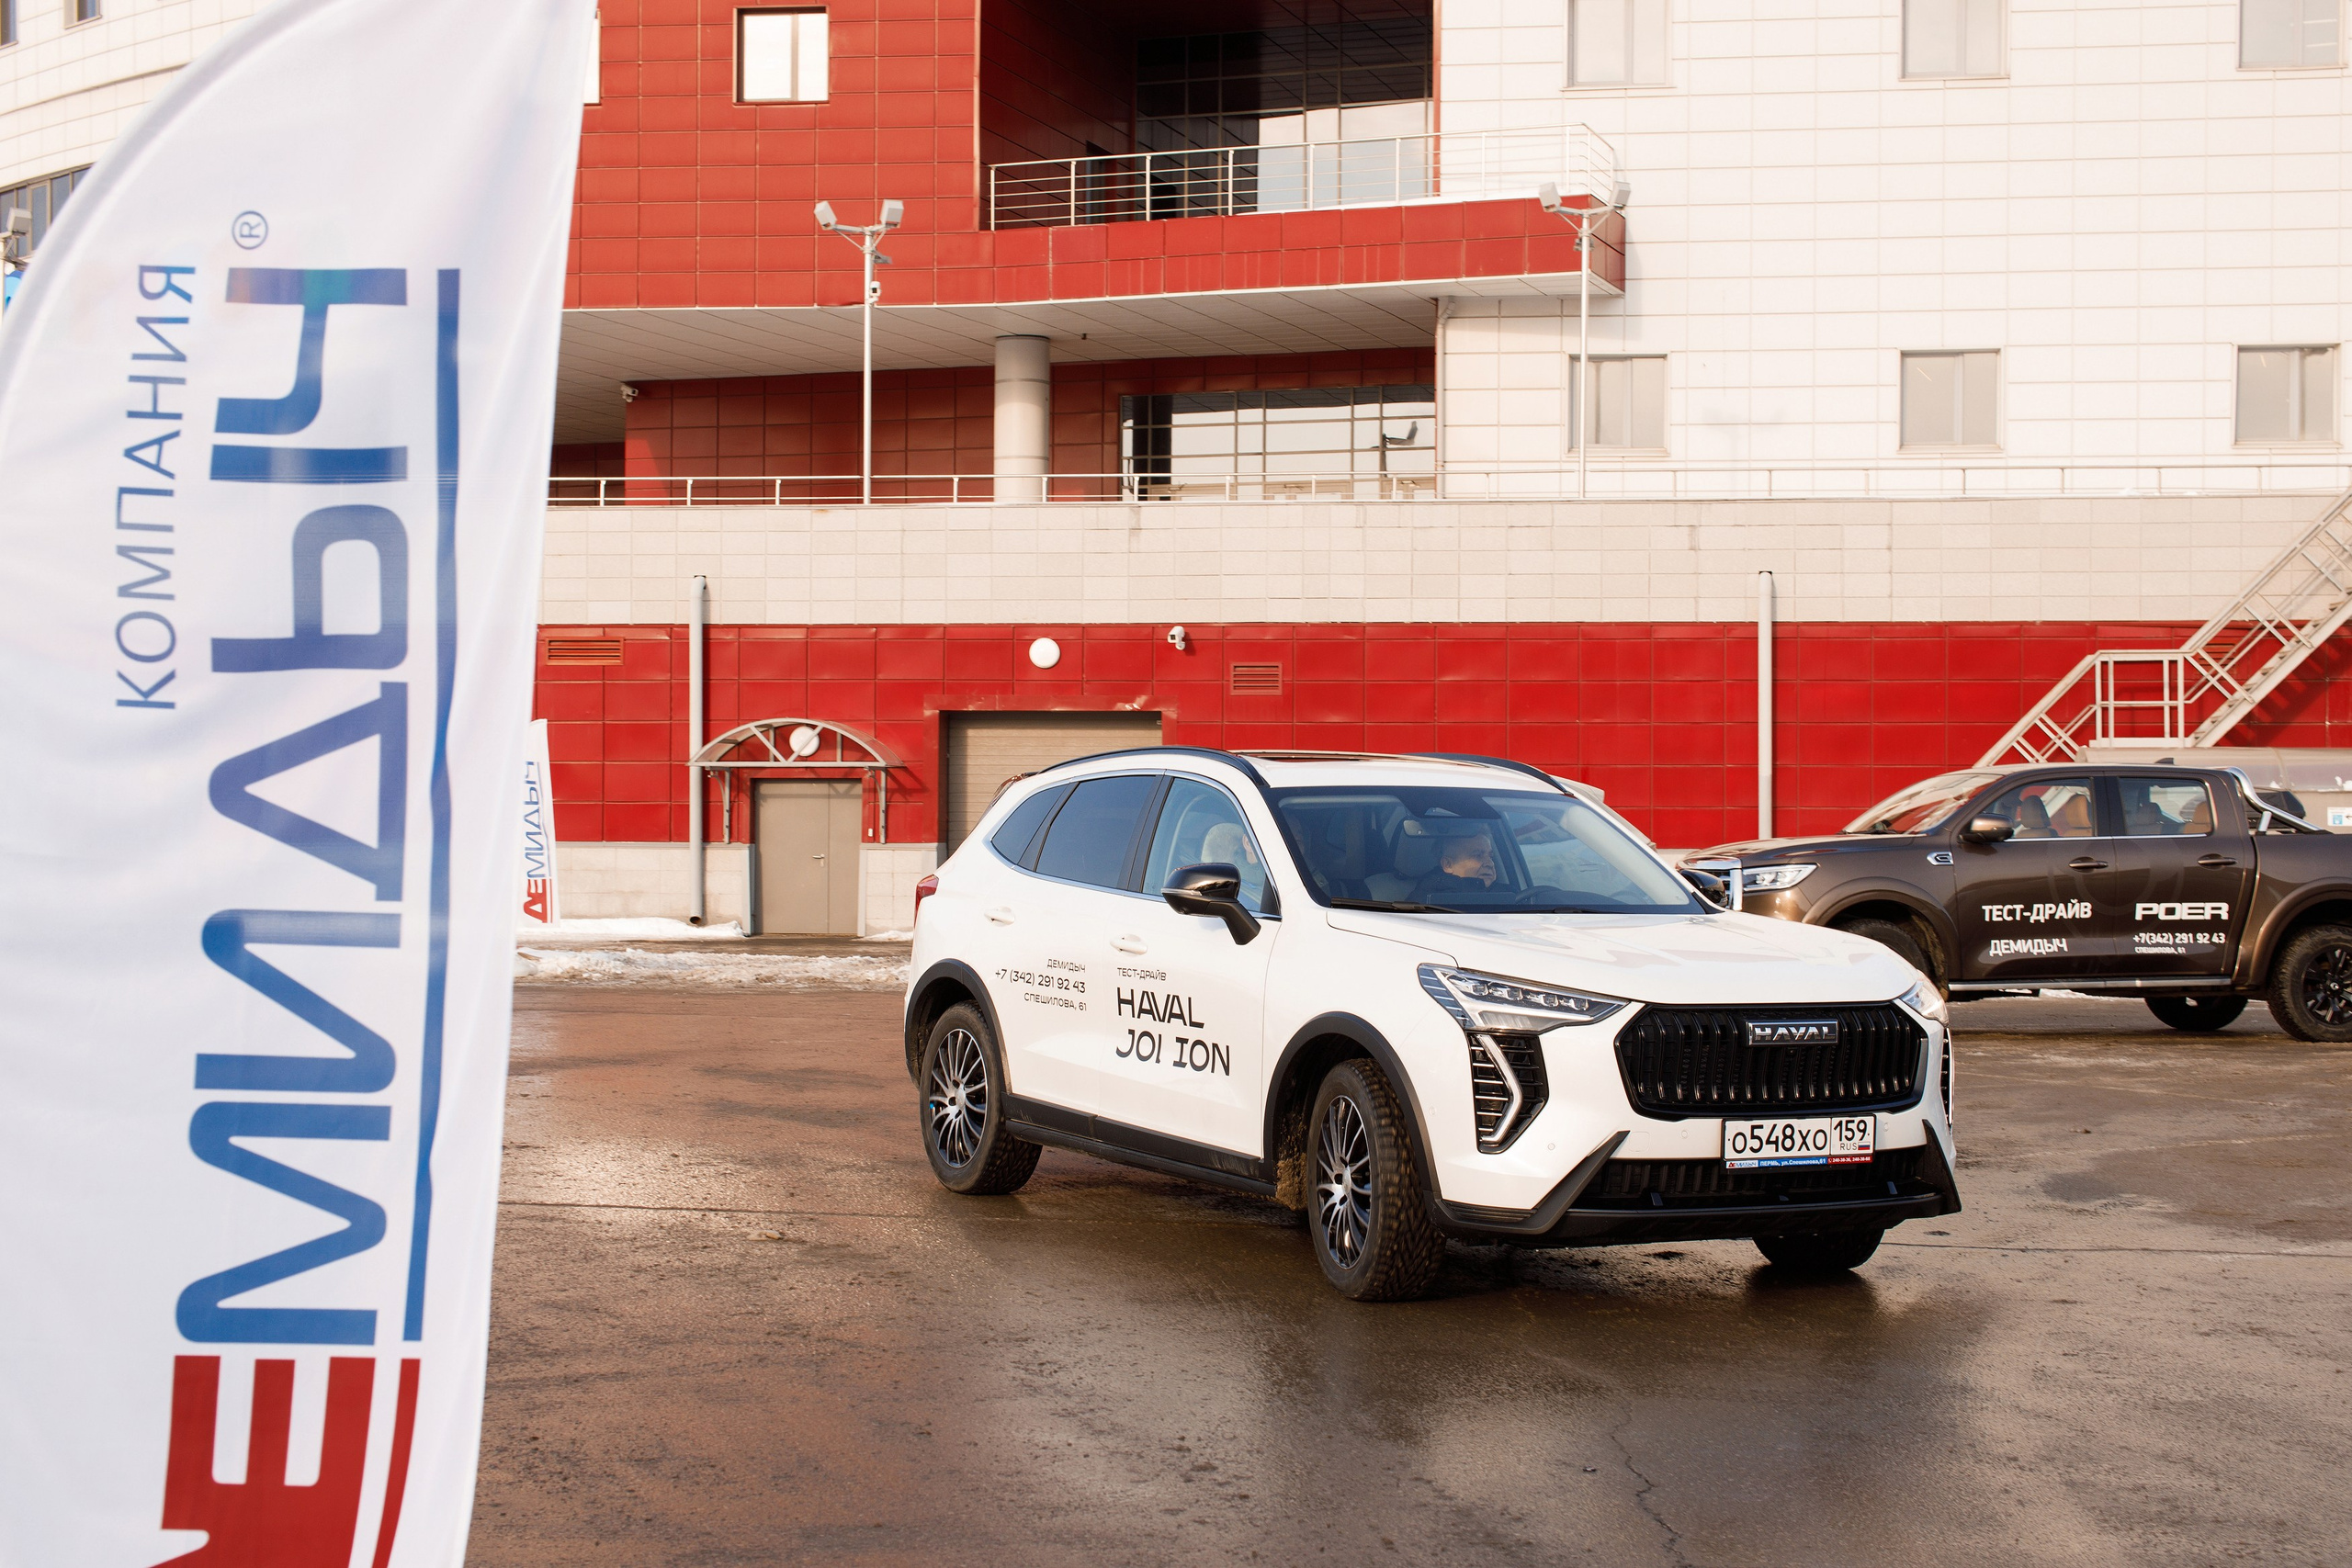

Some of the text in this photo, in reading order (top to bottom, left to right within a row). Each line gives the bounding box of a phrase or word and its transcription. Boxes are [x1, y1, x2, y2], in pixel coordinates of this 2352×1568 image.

[116, 264, 197, 710] КОМПАНИЯ
[147, 267, 409, 1568] ЕМИДЫЧ
[1982, 898, 2093, 923] ТЕСТ-ДРАЙВ
[2134, 902, 2229, 920] POER
[1989, 938, 2069, 956] ДЕМИДЫЧ
[2132, 932, 2226, 945] +7(342) 291 92 43
[1047, 958, 1086, 974] ДЕМИДЫЧ
[1117, 967, 1167, 981] ТЕСТ-ДРАЙВ
[995, 968, 1086, 993] +7 (342) 291 92 43
[1023, 992, 1087, 1011] СПЕШИЛОВА, 61
[1116, 987, 1205, 1029] HAVAL
[1755, 1026, 1837, 1041] HAVAL
[1833, 1119, 1869, 1142] 159
[1839, 1143, 1858, 1151] RUS
